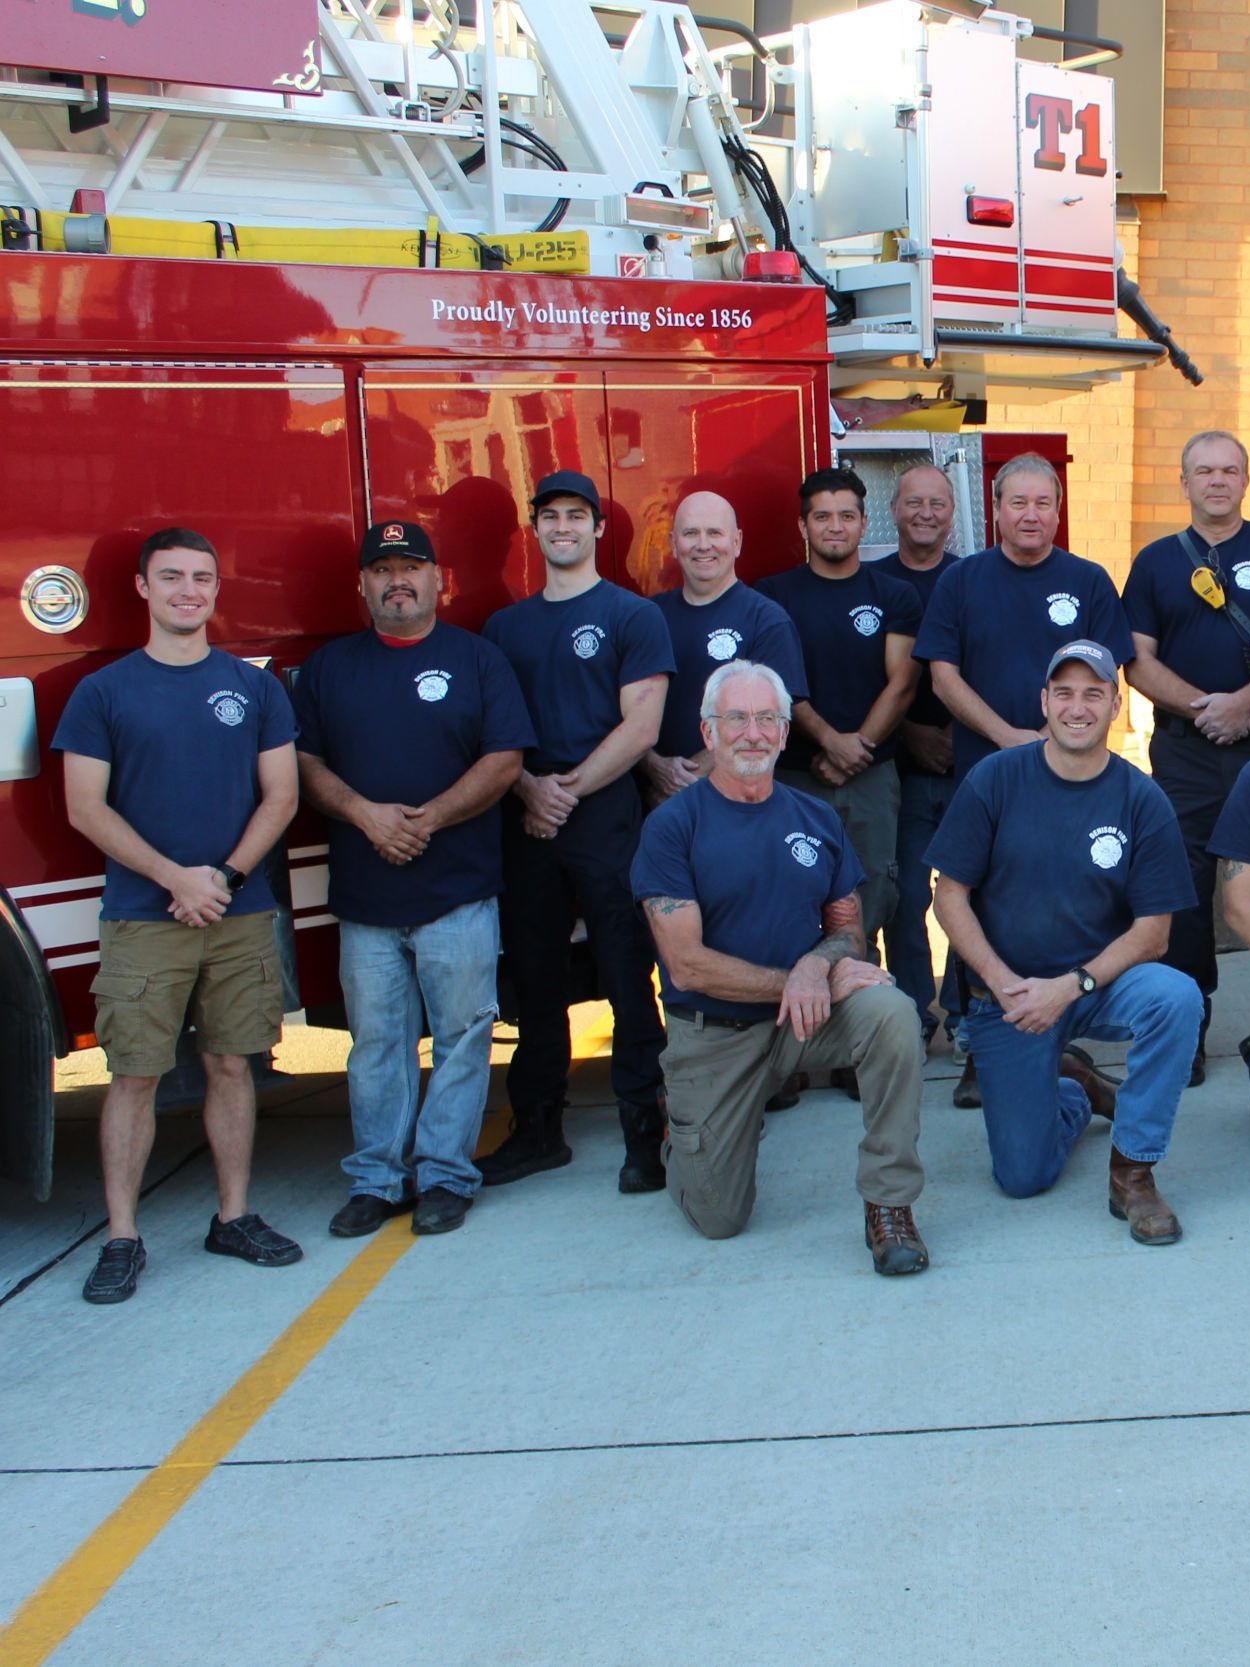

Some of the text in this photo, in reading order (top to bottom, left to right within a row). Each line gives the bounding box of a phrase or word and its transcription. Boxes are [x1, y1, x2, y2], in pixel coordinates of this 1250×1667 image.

[1025, 92, 1107, 177] T1
[431, 299, 752, 332] Proudly Volunteering Since 1856
[1089, 826, 1117, 839] DENISON
